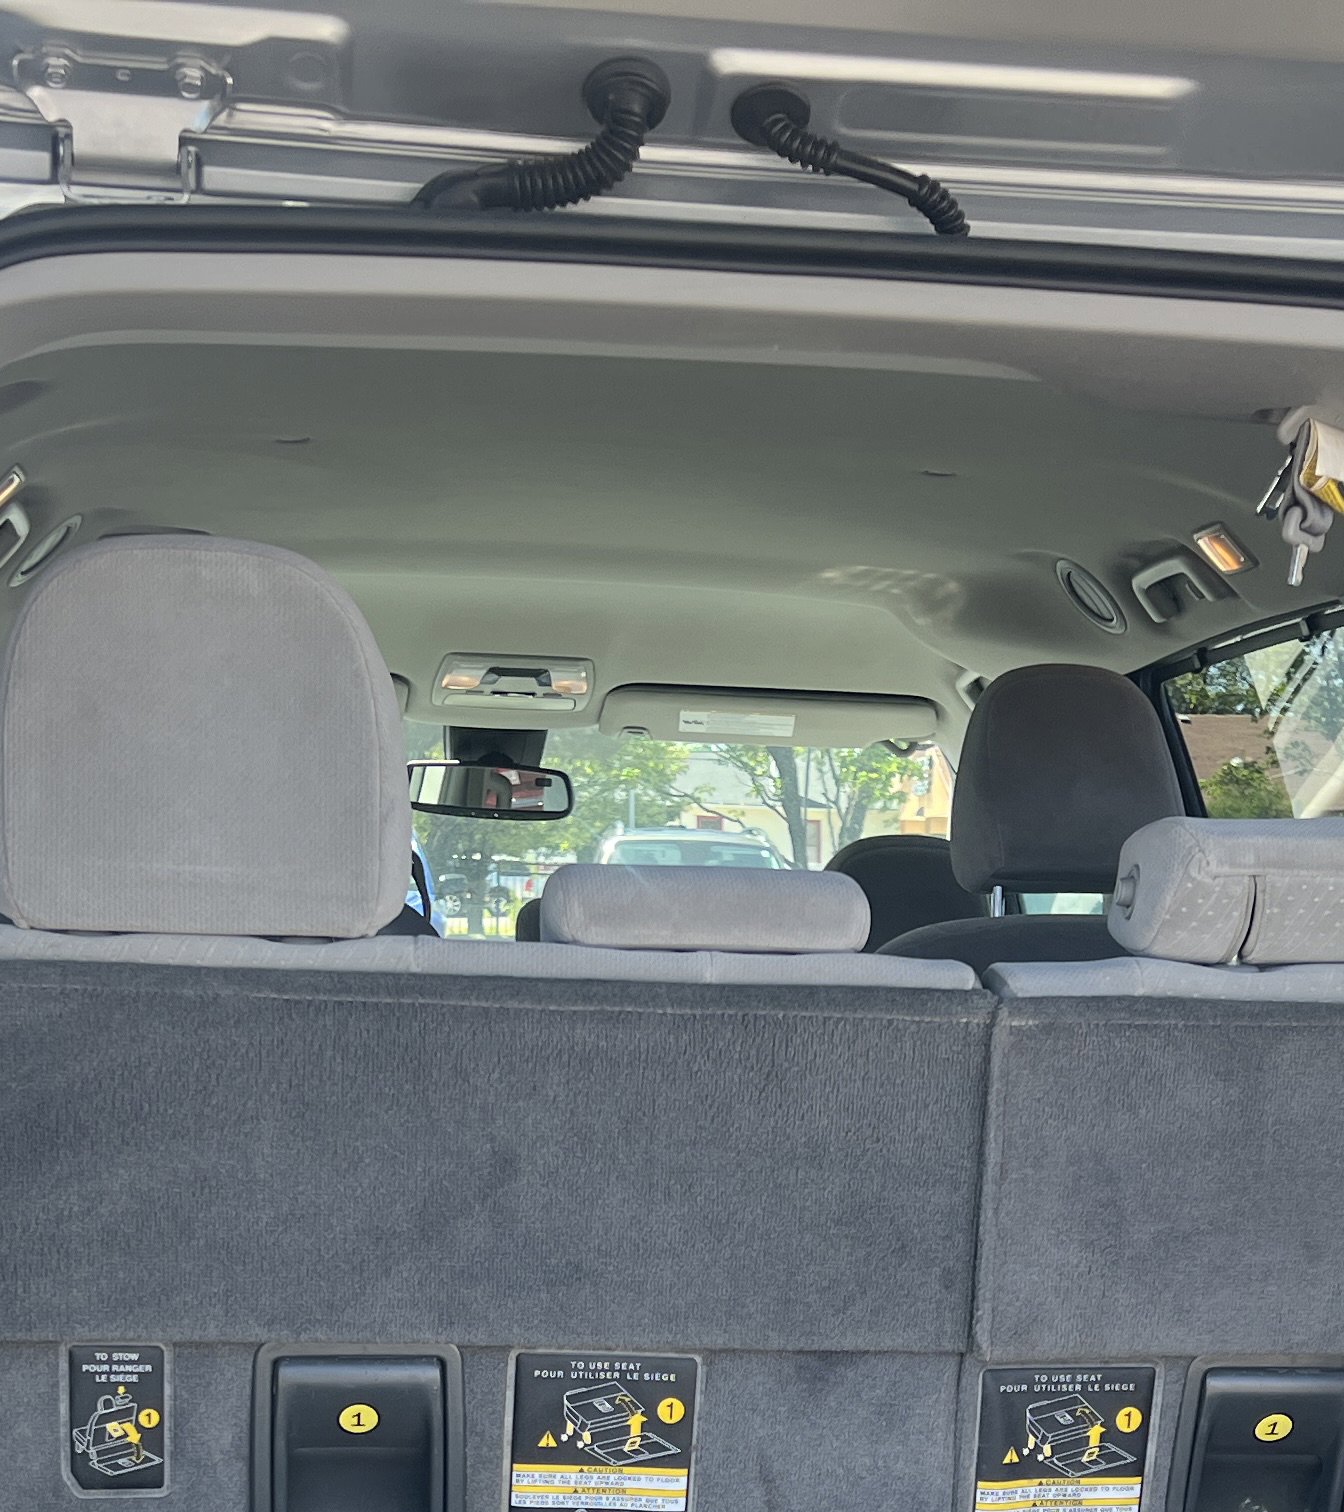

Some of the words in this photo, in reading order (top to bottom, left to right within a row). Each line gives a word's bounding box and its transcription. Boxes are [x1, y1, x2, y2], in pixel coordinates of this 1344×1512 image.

[94, 1352, 109, 1361] TO
[112, 1352, 140, 1361] STOW
[82, 1364, 110, 1373] POUR
[111, 1364, 153, 1373] RANGER
[570, 1361, 585, 1369] TO
[588, 1361, 610, 1370] USE
[614, 1362, 642, 1371] SEAT
[95, 1374, 108, 1383] LE
[534, 1370, 564, 1379] POUR
[570, 1370, 620, 1380] UTILISER
[626, 1372, 639, 1381] LE
[1034, 1374, 1048, 1383] TO
[1051, 1374, 1072, 1383] USE
[1075, 1373, 1103, 1382] SEAT
[1000, 1384, 1028, 1393] POUR
[1033, 1383, 1082, 1393] UTILISER
[1087, 1383, 1100, 1392] LE
[665, 1402, 674, 1421] 1
[144, 1412, 153, 1425] 1
[350, 1412, 366, 1427] 1
[1123, 1411, 1132, 1428] 1
[1265, 1421, 1279, 1436] 1
[581, 1487, 627, 1495] ATTENTION
